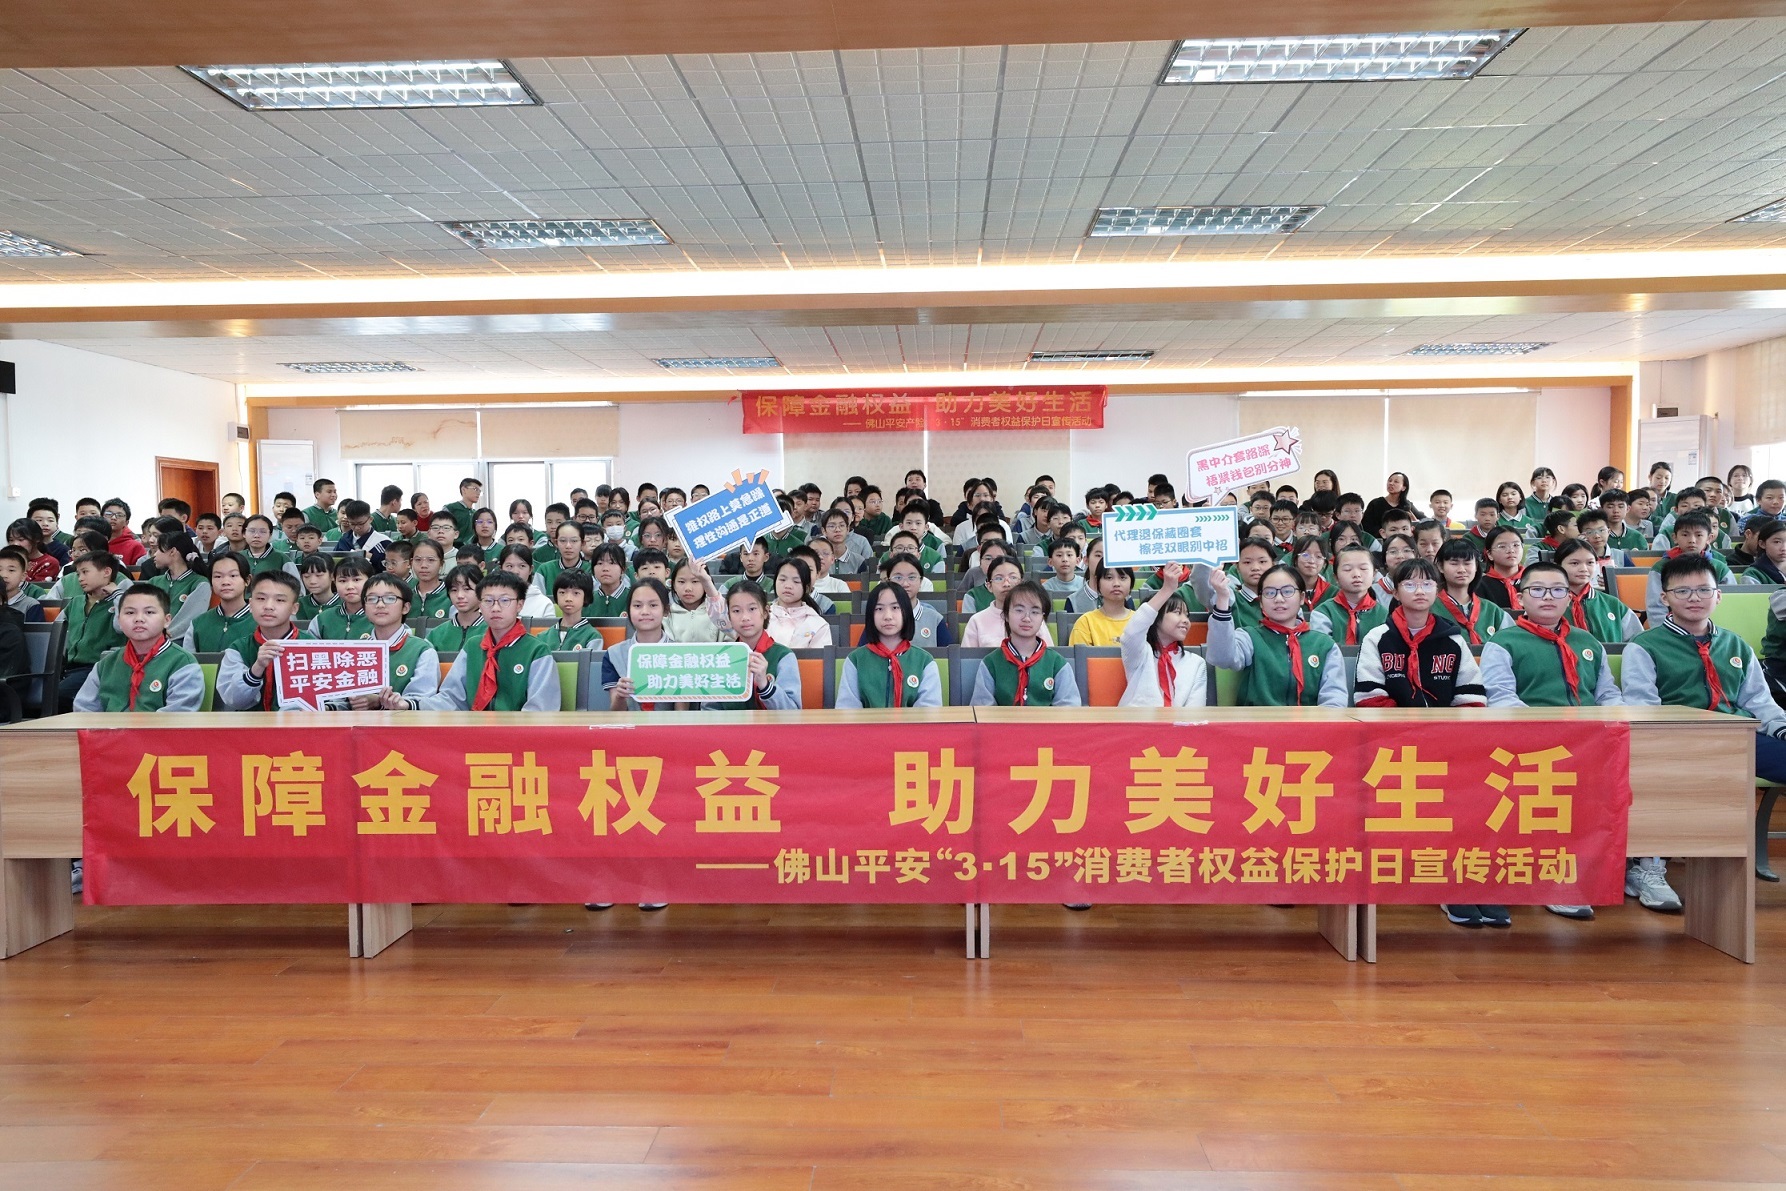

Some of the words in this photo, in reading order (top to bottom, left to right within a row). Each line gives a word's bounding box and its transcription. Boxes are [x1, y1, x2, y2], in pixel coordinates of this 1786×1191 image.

[756, 393, 912, 417] 保障金融权益
[935, 390, 1092, 414] 助力美好生活
[1196, 444, 1271, 472] 黑中介套路深
[684, 486, 766, 534] 维权路上莫急躁
[692, 502, 773, 549] 理性沟通是正道
[1114, 526, 1202, 542] 代理退保藏圈套
[1139, 539, 1228, 555] 擦亮双眼别中招
[286, 651, 378, 672] 扫黑除恶
[637, 653, 731, 669] 保障金融权益
[289, 668, 379, 694] 平安金融
[647, 673, 741, 689] 助力美好生活
[126, 749, 782, 838] 保障金融权益
[888, 745, 1578, 836] 助力美好生活
